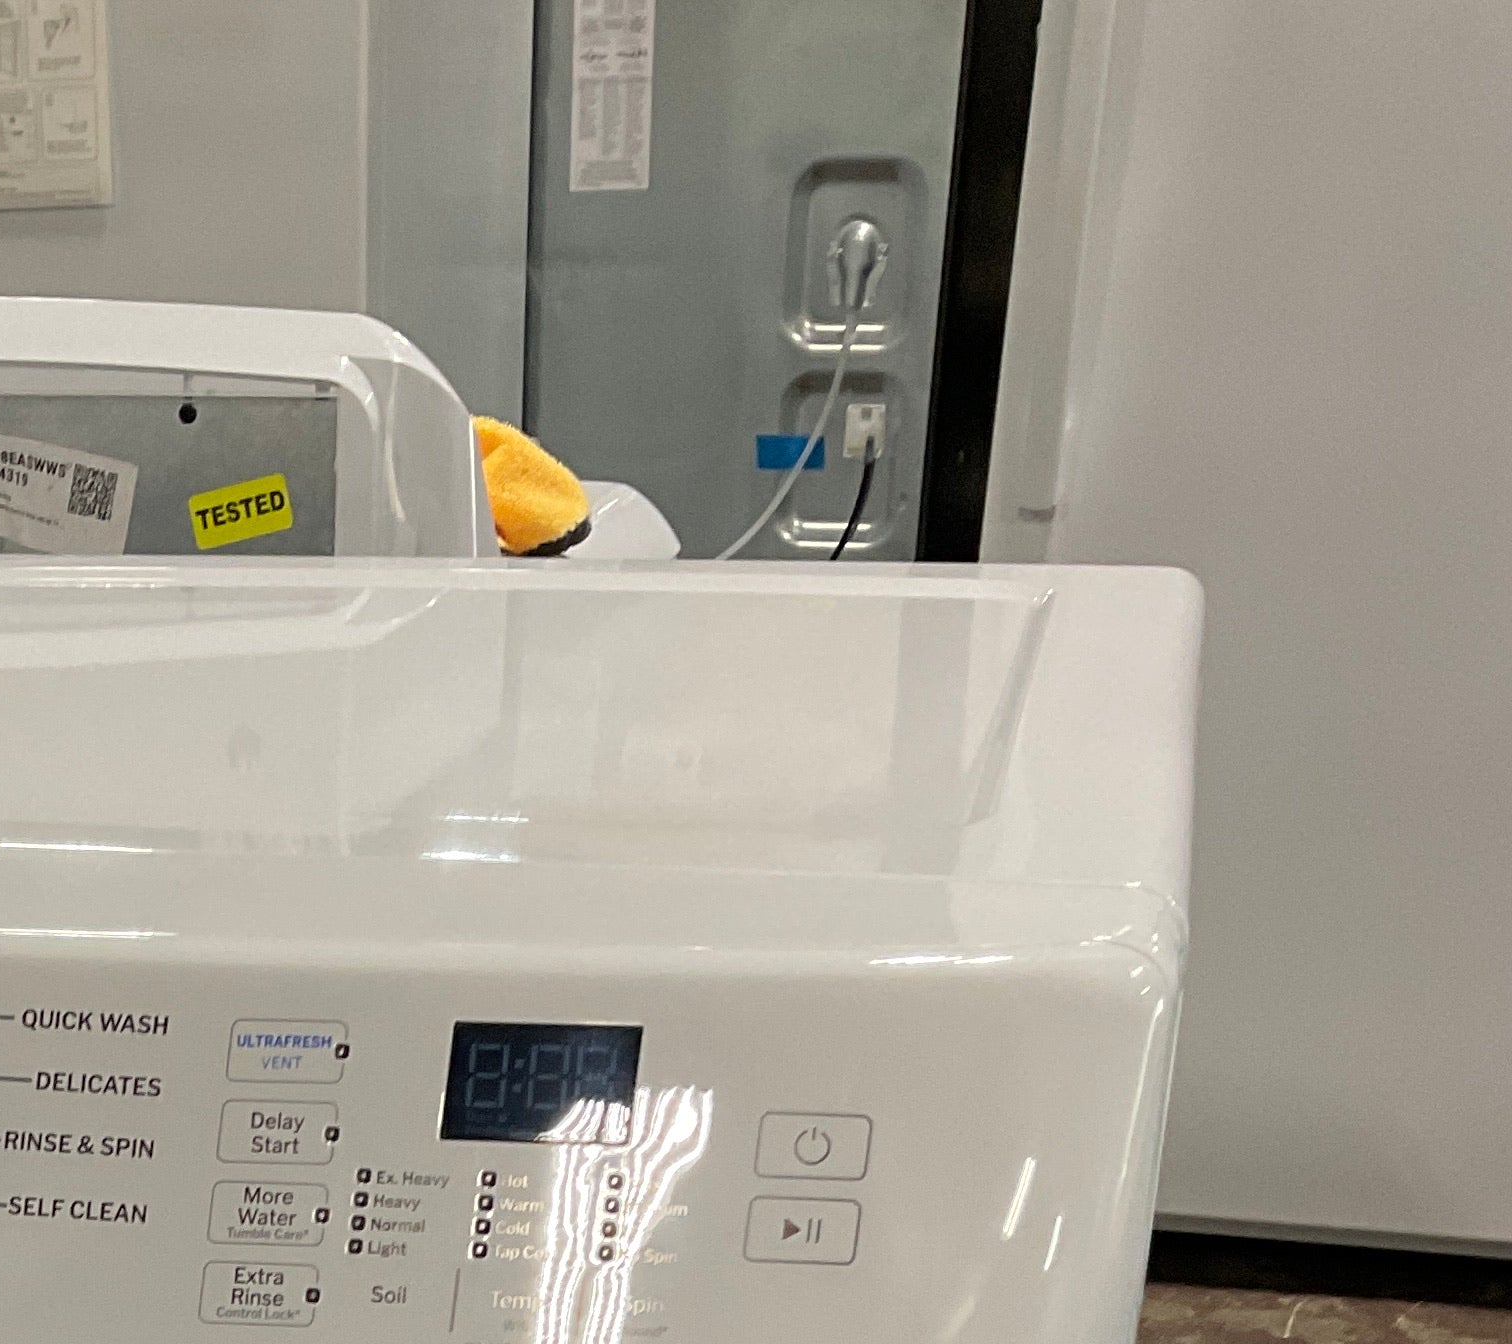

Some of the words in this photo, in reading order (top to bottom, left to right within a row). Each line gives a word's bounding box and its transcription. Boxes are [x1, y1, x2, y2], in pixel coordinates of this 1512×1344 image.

[195, 490, 285, 530] TESTED
[21, 1009, 93, 1031] QUICK
[100, 1014, 169, 1035] WASH
[237, 1035, 333, 1049] ULTRAFRESH
[261, 1056, 303, 1070] VENT
[35, 1071, 162, 1097] DELICATES
[250, 1112, 305, 1133] Delay
[4, 1131, 72, 1153] RINSE
[77, 1136, 94, 1155] &
[100, 1138, 154, 1158] SPIN
[251, 1136, 300, 1154] Start
[376, 1170, 397, 1185] Ex.
[402, 1171, 450, 1188] Heavy
[243, 1186, 294, 1205] More
[373, 1194, 421, 1211] Heavy
[499, 1197, 544, 1212] Warm
[8, 1196, 64, 1217] SELF
[70, 1201, 147, 1223] CLEAN
[238, 1208, 296, 1227] Water
[370, 1218, 426, 1232] Normal
[495, 1220, 531, 1236] Cold
[368, 1240, 407, 1257] Light
[643, 1249, 678, 1265] Spin
[234, 1268, 284, 1286] Extra
[231, 1288, 284, 1306] Rinse
[370, 1285, 407, 1304] Soil
[216, 1306, 262, 1319] Control
